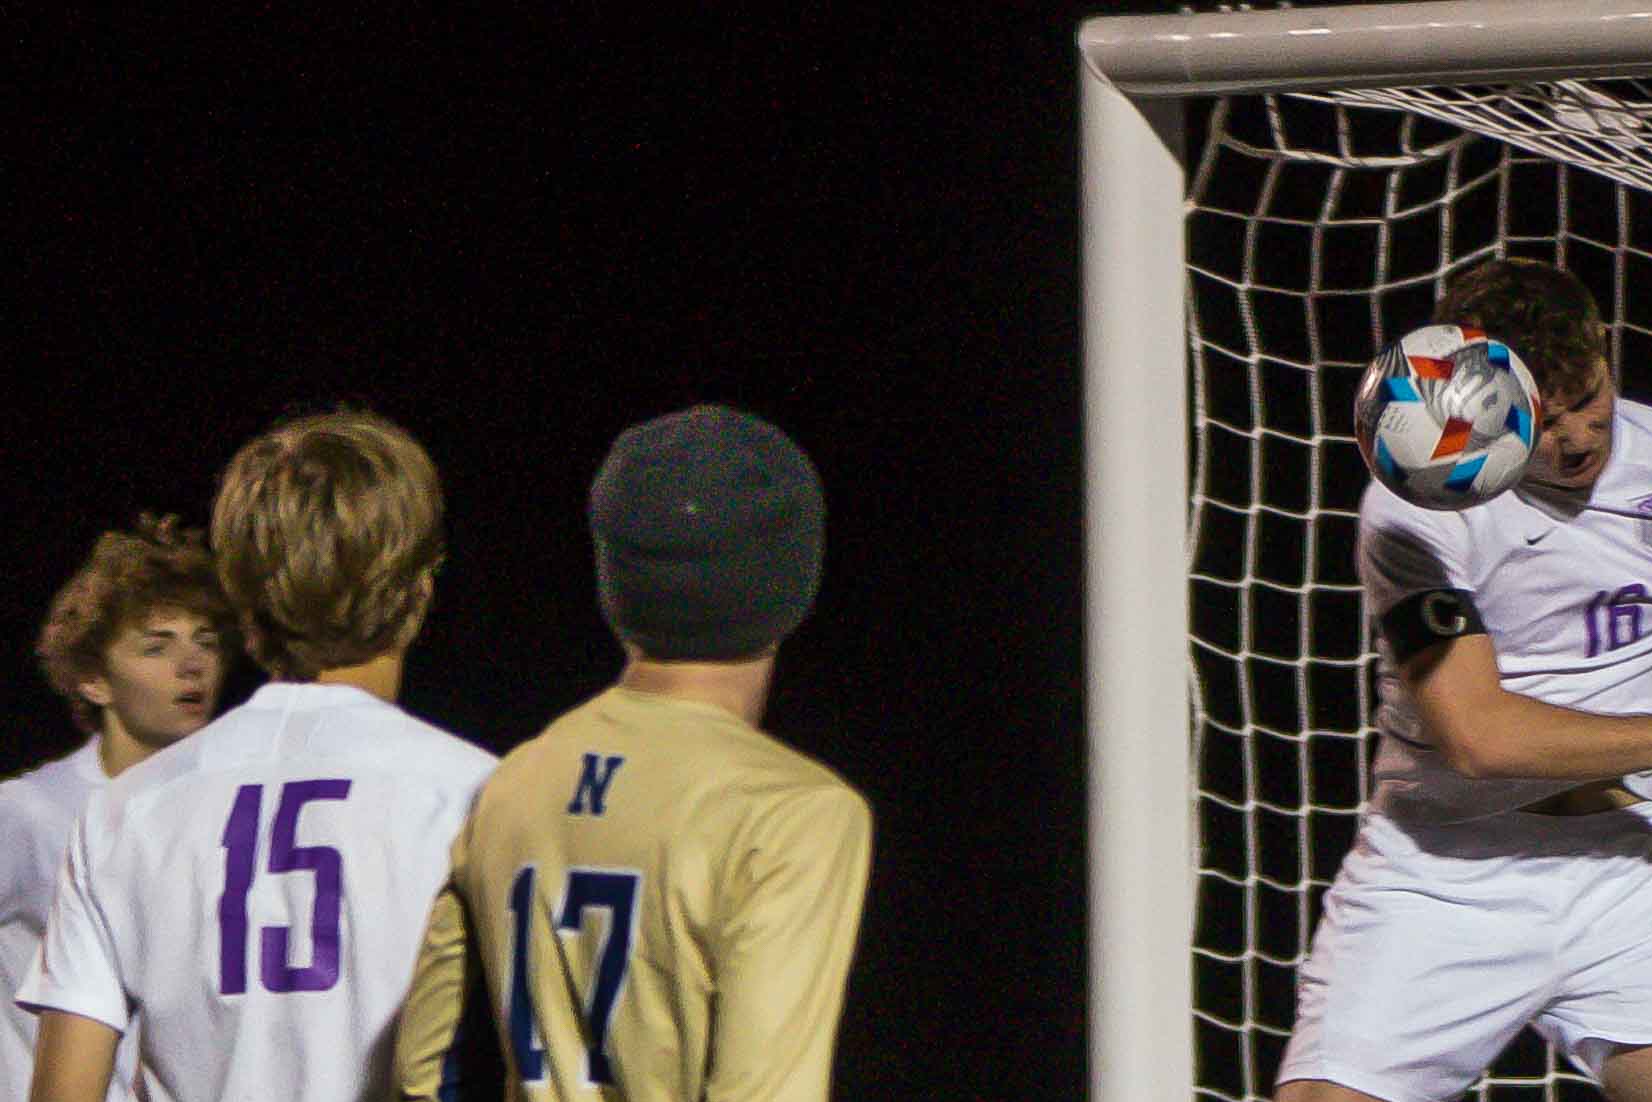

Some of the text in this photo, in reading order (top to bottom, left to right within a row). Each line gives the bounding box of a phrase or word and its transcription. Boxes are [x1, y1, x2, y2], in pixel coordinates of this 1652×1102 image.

[218, 778, 353, 996] 15
[566, 752, 626, 817] N
[510, 865, 641, 1087] 17
